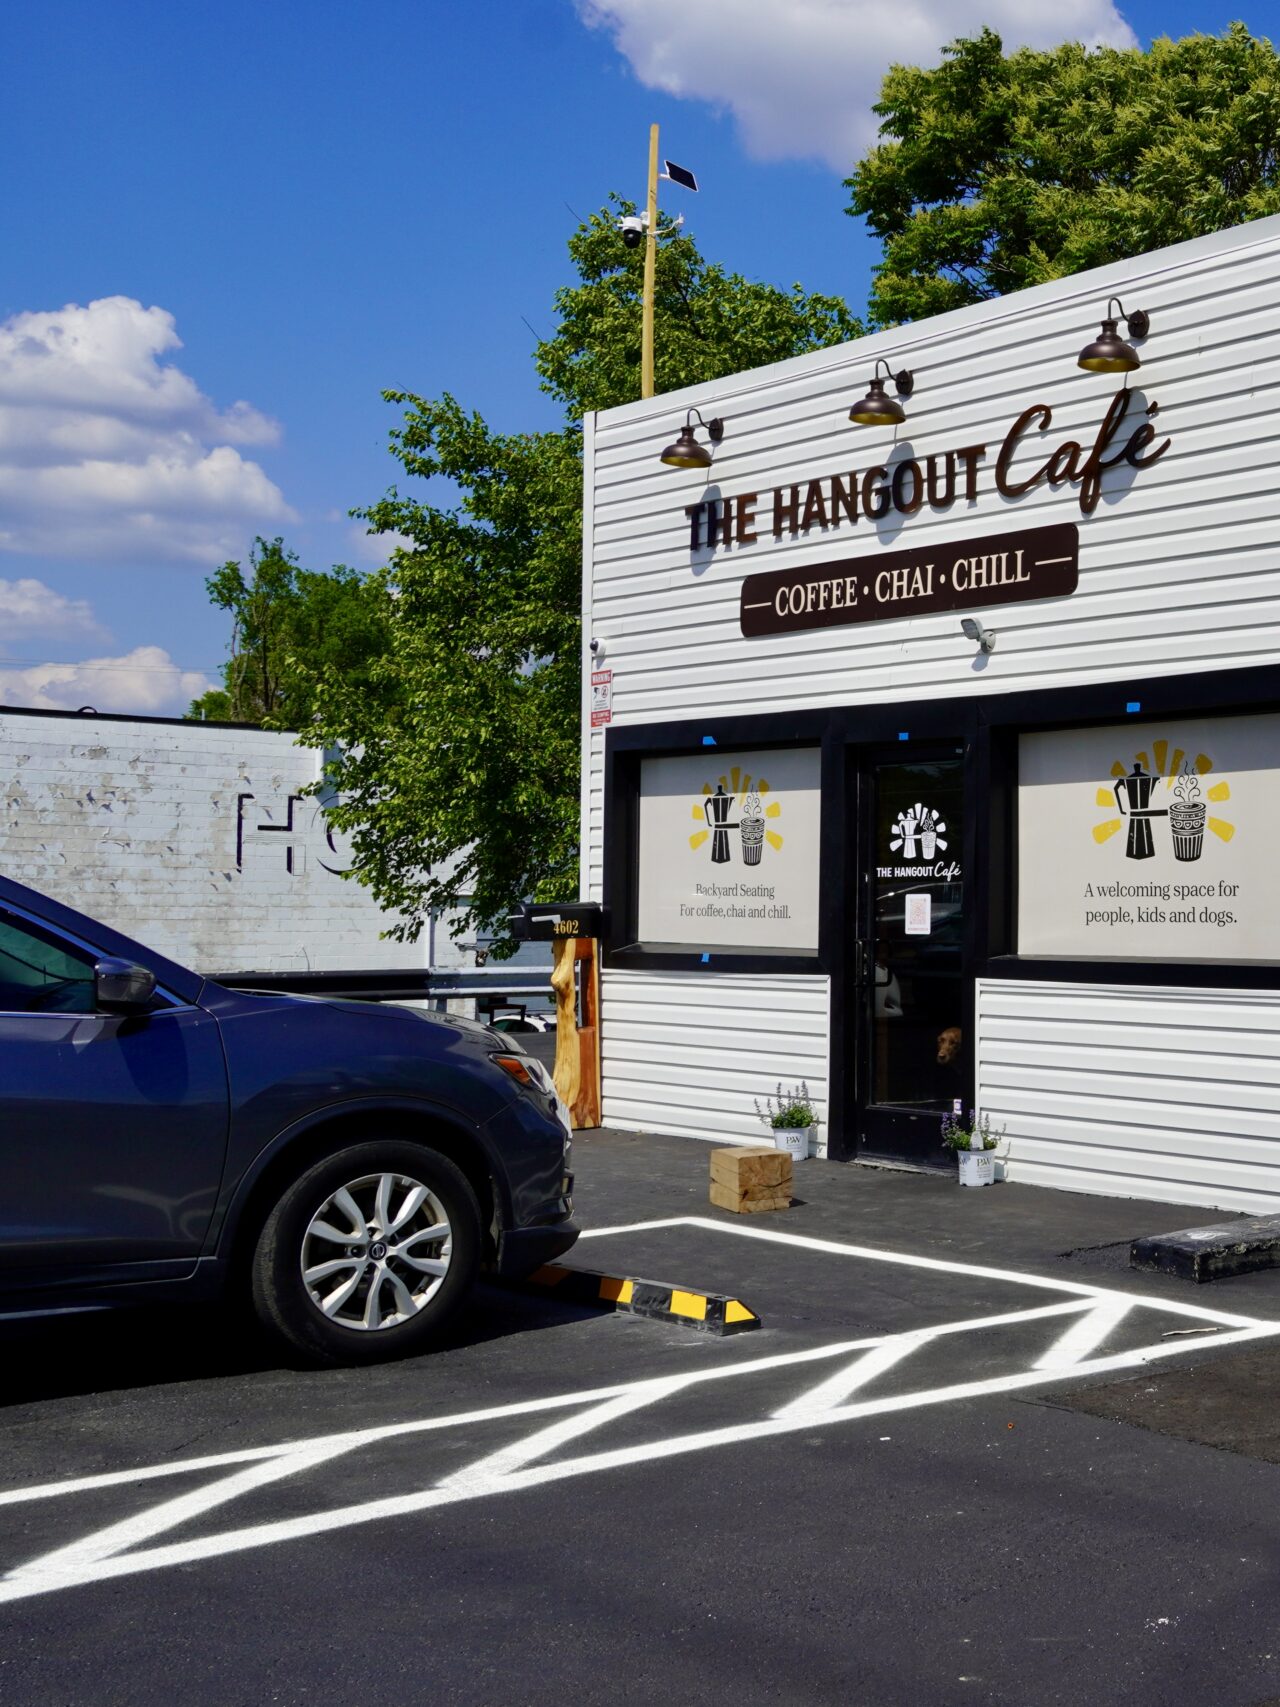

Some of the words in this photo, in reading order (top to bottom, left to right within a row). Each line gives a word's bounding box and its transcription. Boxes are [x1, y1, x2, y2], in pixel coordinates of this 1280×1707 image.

[685, 494, 758, 551] THE
[773, 444, 987, 537] HANGOUT
[775, 576, 858, 617] COFFEE
[874, 564, 935, 603] CHAI
[952, 549, 1031, 592] CHILL
[876, 867, 892, 878] THE
[894, 866, 934, 878] HANGOUT
[934, 861, 962, 882] Café
[696, 883, 738, 899] Backyard
[739, 883, 775, 901] Seating
[1084, 882, 1095, 897] A
[1096, 881, 1171, 901] welcoming
[1173, 884, 1215, 901] space
[1218, 880, 1240, 897] for
[680, 903, 695, 917] For
[726, 904, 746, 918] chai
[748, 904, 766, 918] and
[767, 904, 791, 919] chill.
[1085, 906, 1134, 926] people,
[1137, 906, 1166, 923] kids
[1169, 906, 1196, 923] and
[1199, 906, 1238, 927] dogs.
[553, 919, 579, 934] 4602
